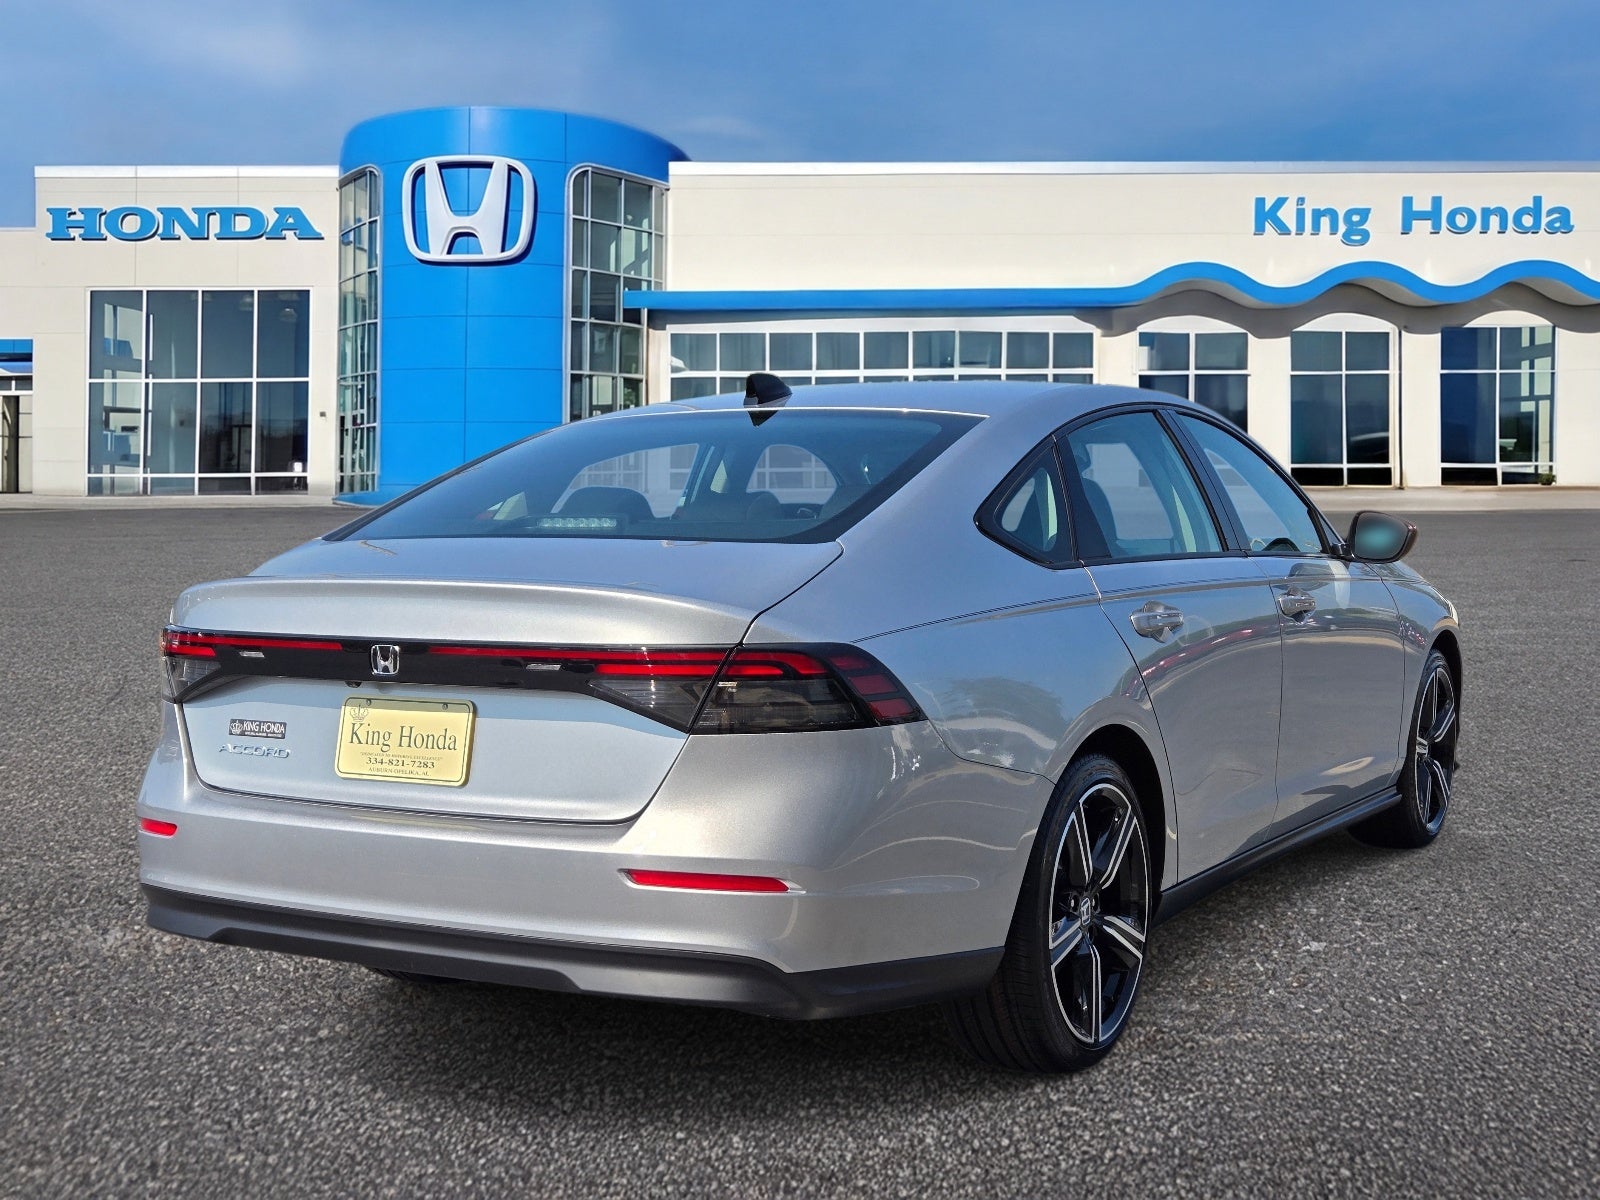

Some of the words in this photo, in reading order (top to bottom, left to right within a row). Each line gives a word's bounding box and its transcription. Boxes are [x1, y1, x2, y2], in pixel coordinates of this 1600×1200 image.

[46, 206, 325, 242] HONDA
[1253, 196, 1372, 247] King
[1400, 195, 1574, 235] Honda
[243, 721, 260, 732] KING
[260, 722, 285, 734] HONDA
[349, 722, 392, 753] King
[397, 725, 457, 751] Honda
[219, 743, 291, 759] ACCORD
[366, 756, 435, 769] 334-821-7283
